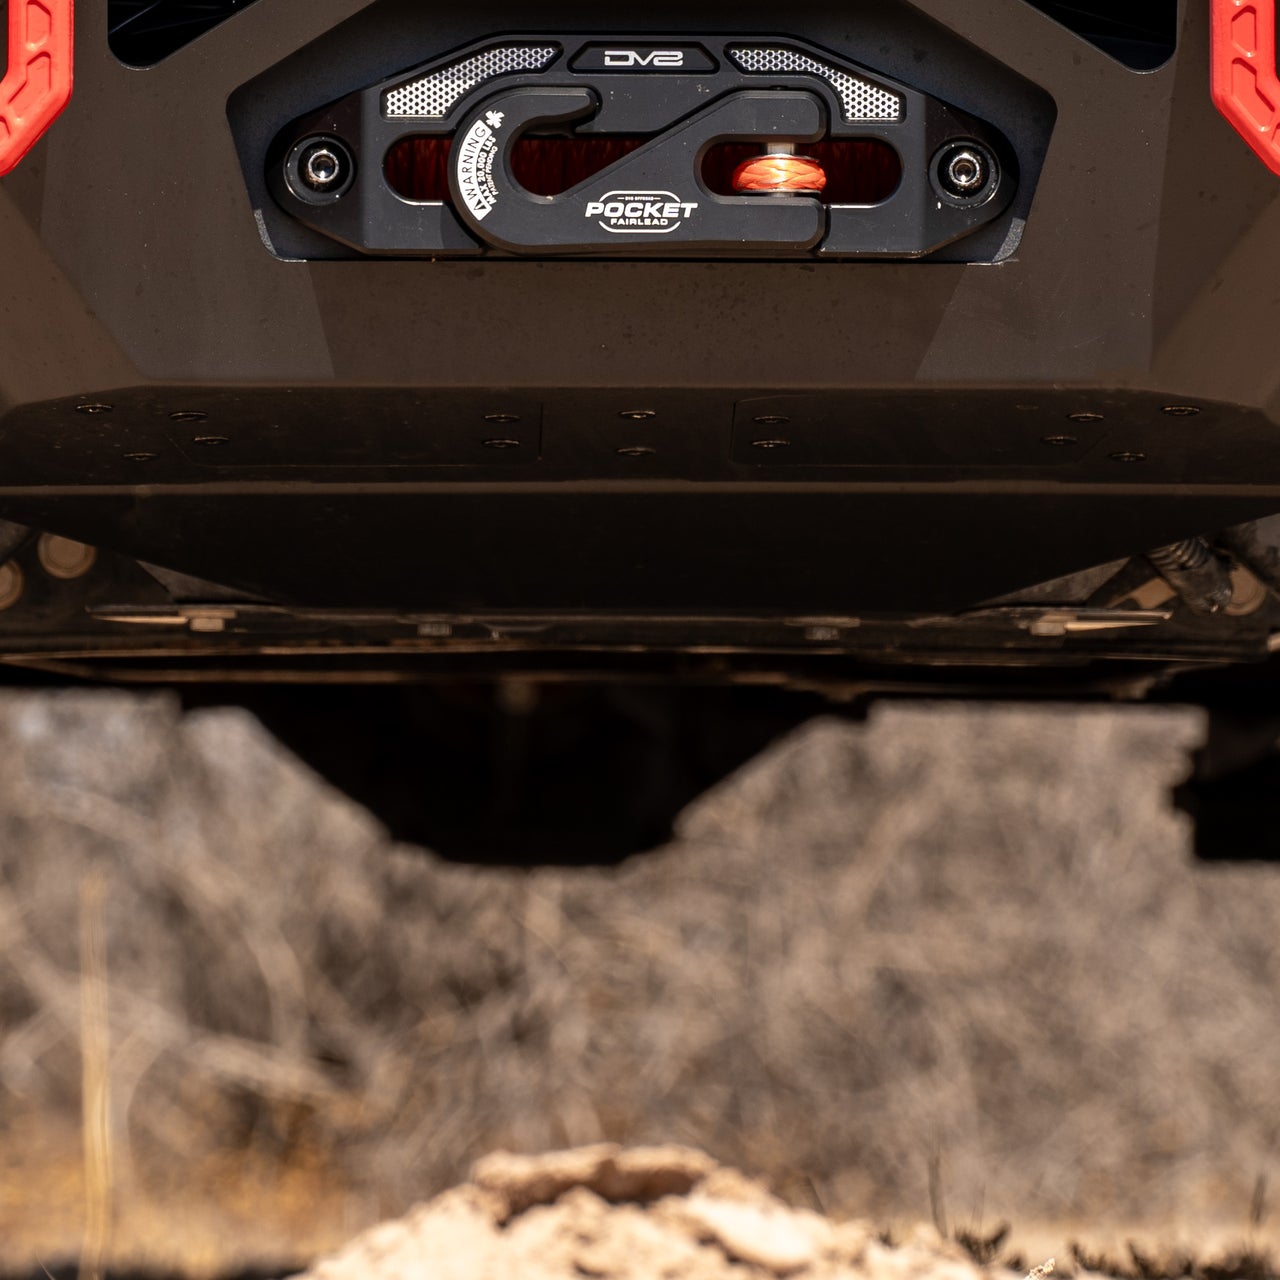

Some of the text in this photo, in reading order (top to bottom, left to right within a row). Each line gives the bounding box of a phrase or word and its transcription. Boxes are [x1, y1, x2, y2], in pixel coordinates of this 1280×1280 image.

[461, 126, 486, 200] WARNING
[477, 135, 497, 205] MAX 20,000 LBS
[485, 145, 498, 173] PENDING
[585, 202, 698, 218] POCKET
[610, 218, 668, 226] FAIRLEAD
